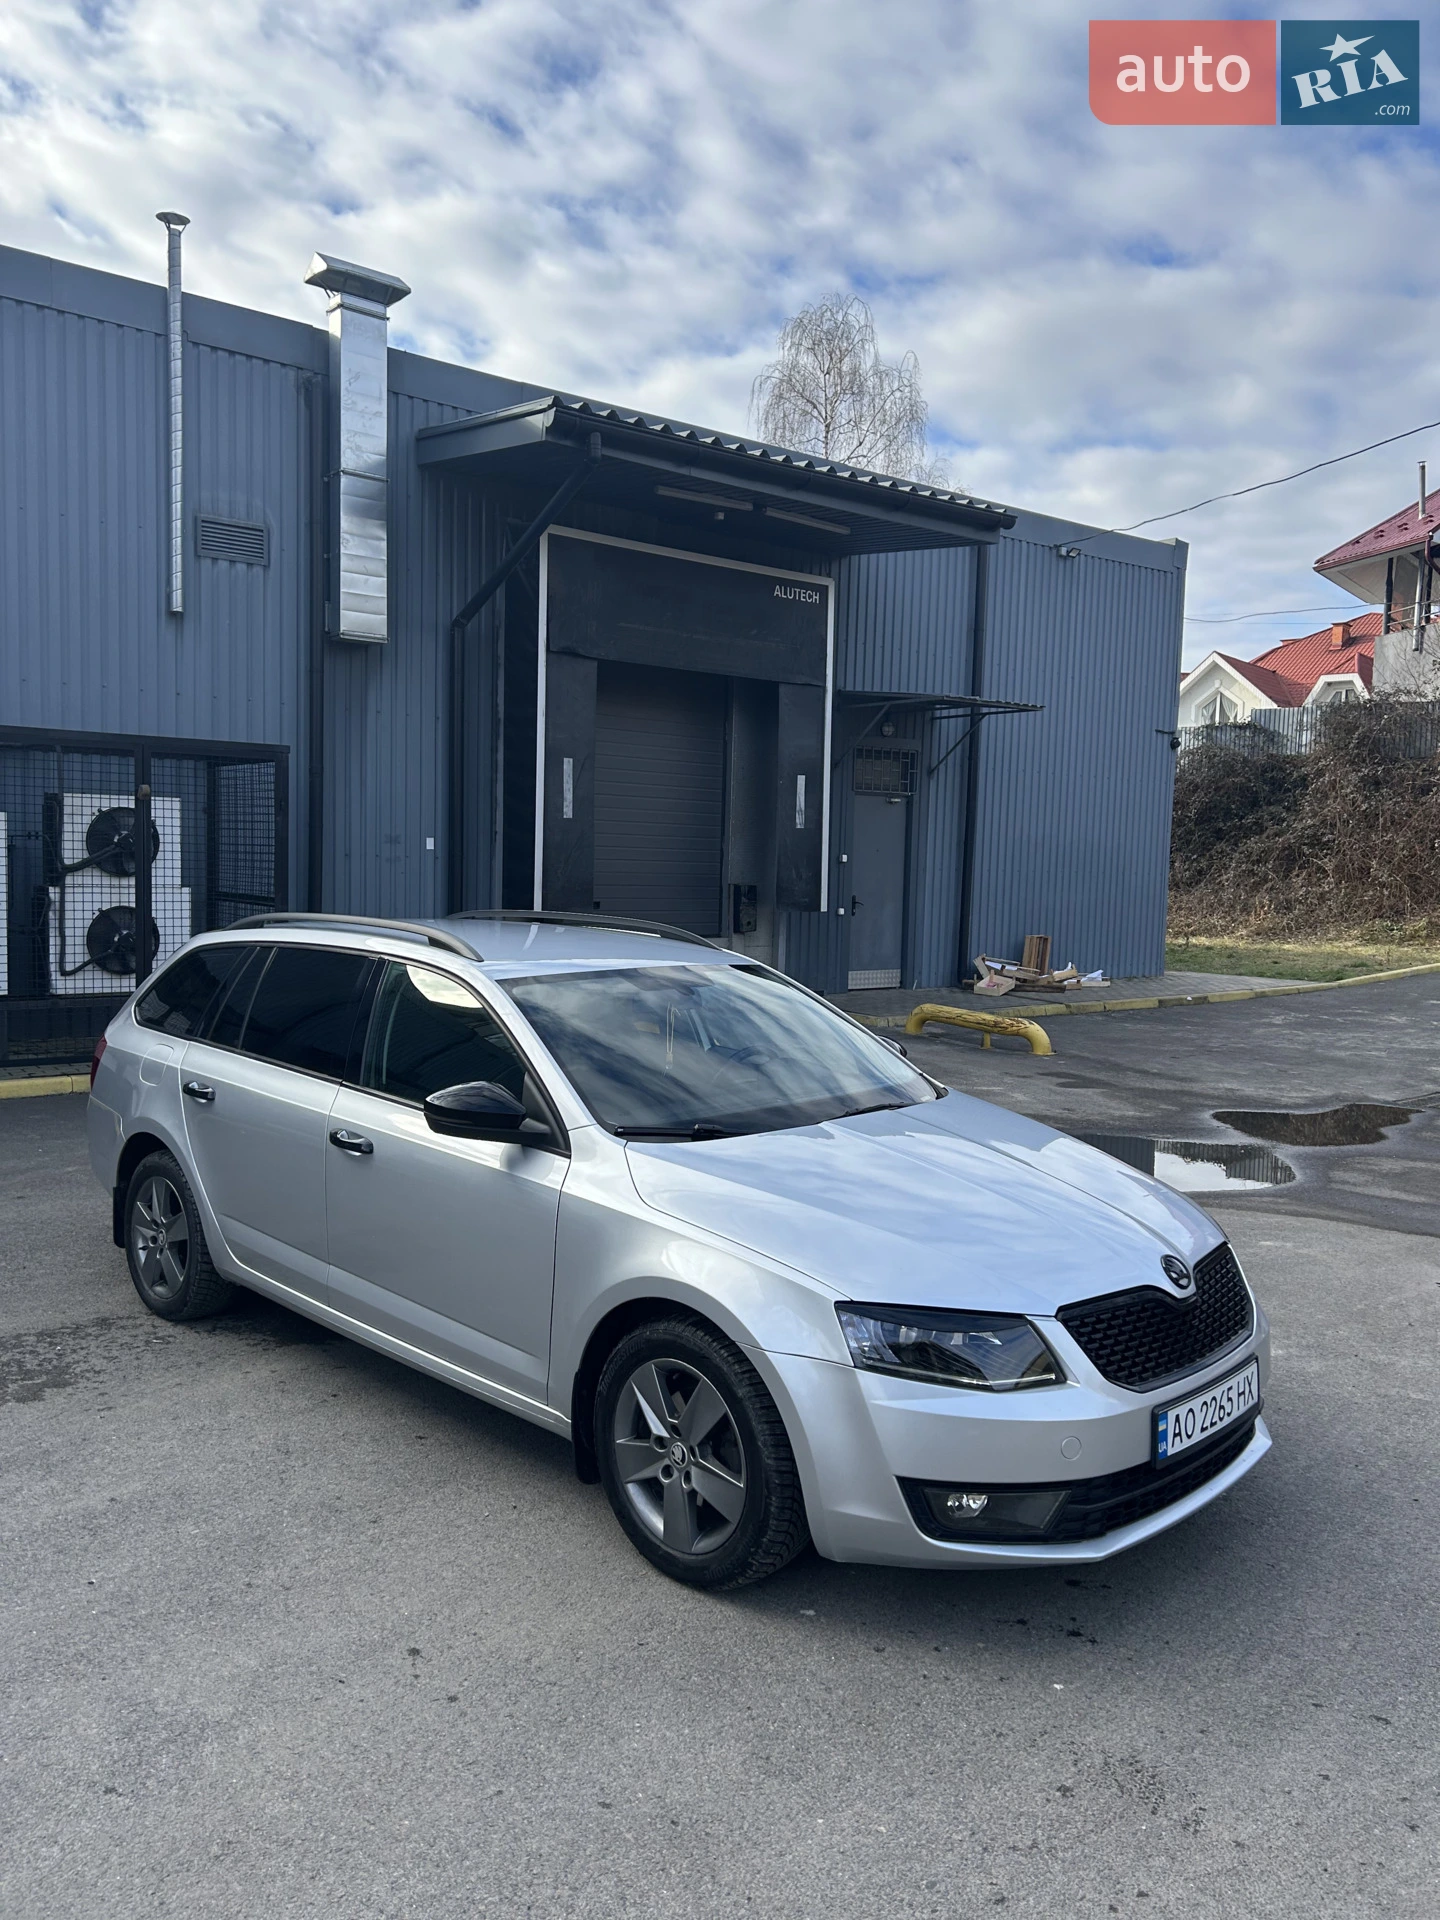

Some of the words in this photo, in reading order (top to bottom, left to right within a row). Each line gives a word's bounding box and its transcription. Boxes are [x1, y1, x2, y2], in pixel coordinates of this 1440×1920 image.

[773, 584, 820, 604] ALUTECH
[1171, 1407, 1196, 1448] AO
[1200, 1385, 1234, 1434] 2265
[1236, 1371, 1255, 1412] HX
